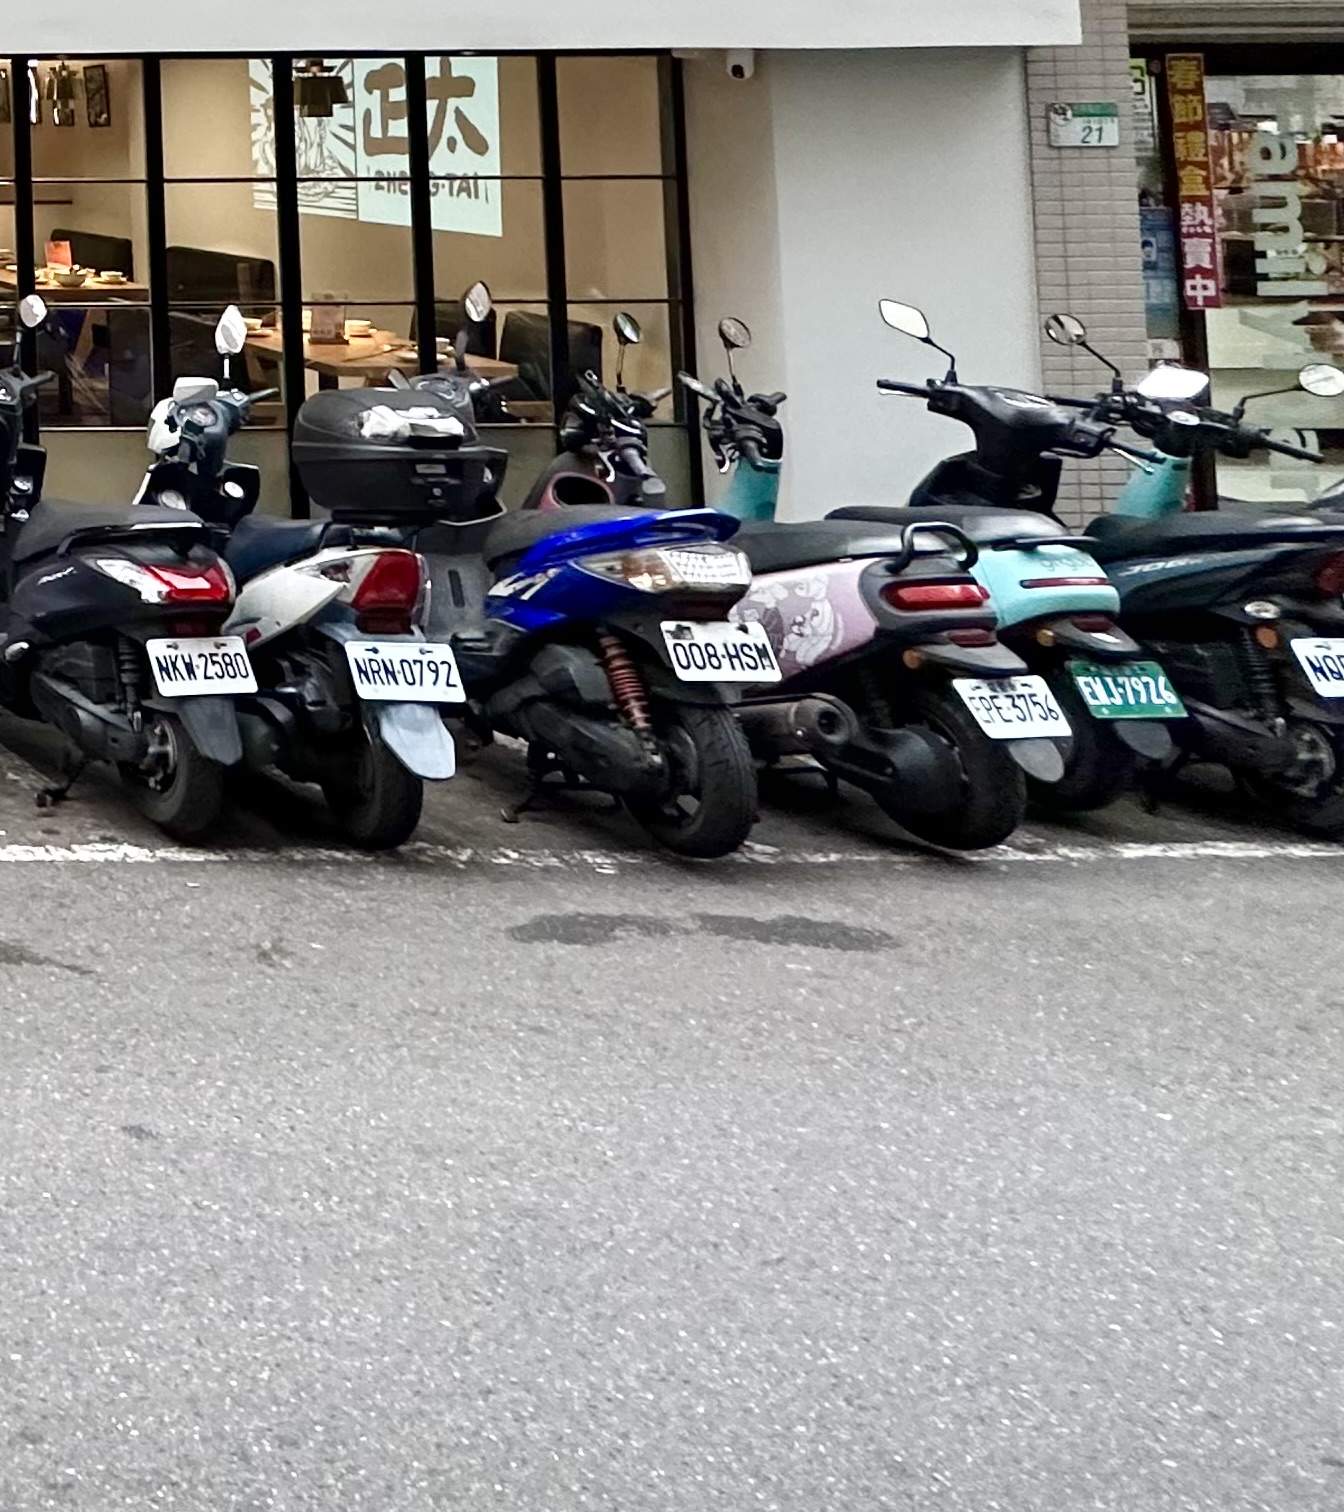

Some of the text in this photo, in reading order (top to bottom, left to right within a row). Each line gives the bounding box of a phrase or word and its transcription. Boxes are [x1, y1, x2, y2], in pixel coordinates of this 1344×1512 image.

[363, 56, 490, 161] 正太
[1080, 125, 1104, 144] 21
[1168, 59, 1217, 307] 春節禮盒熱賣中
